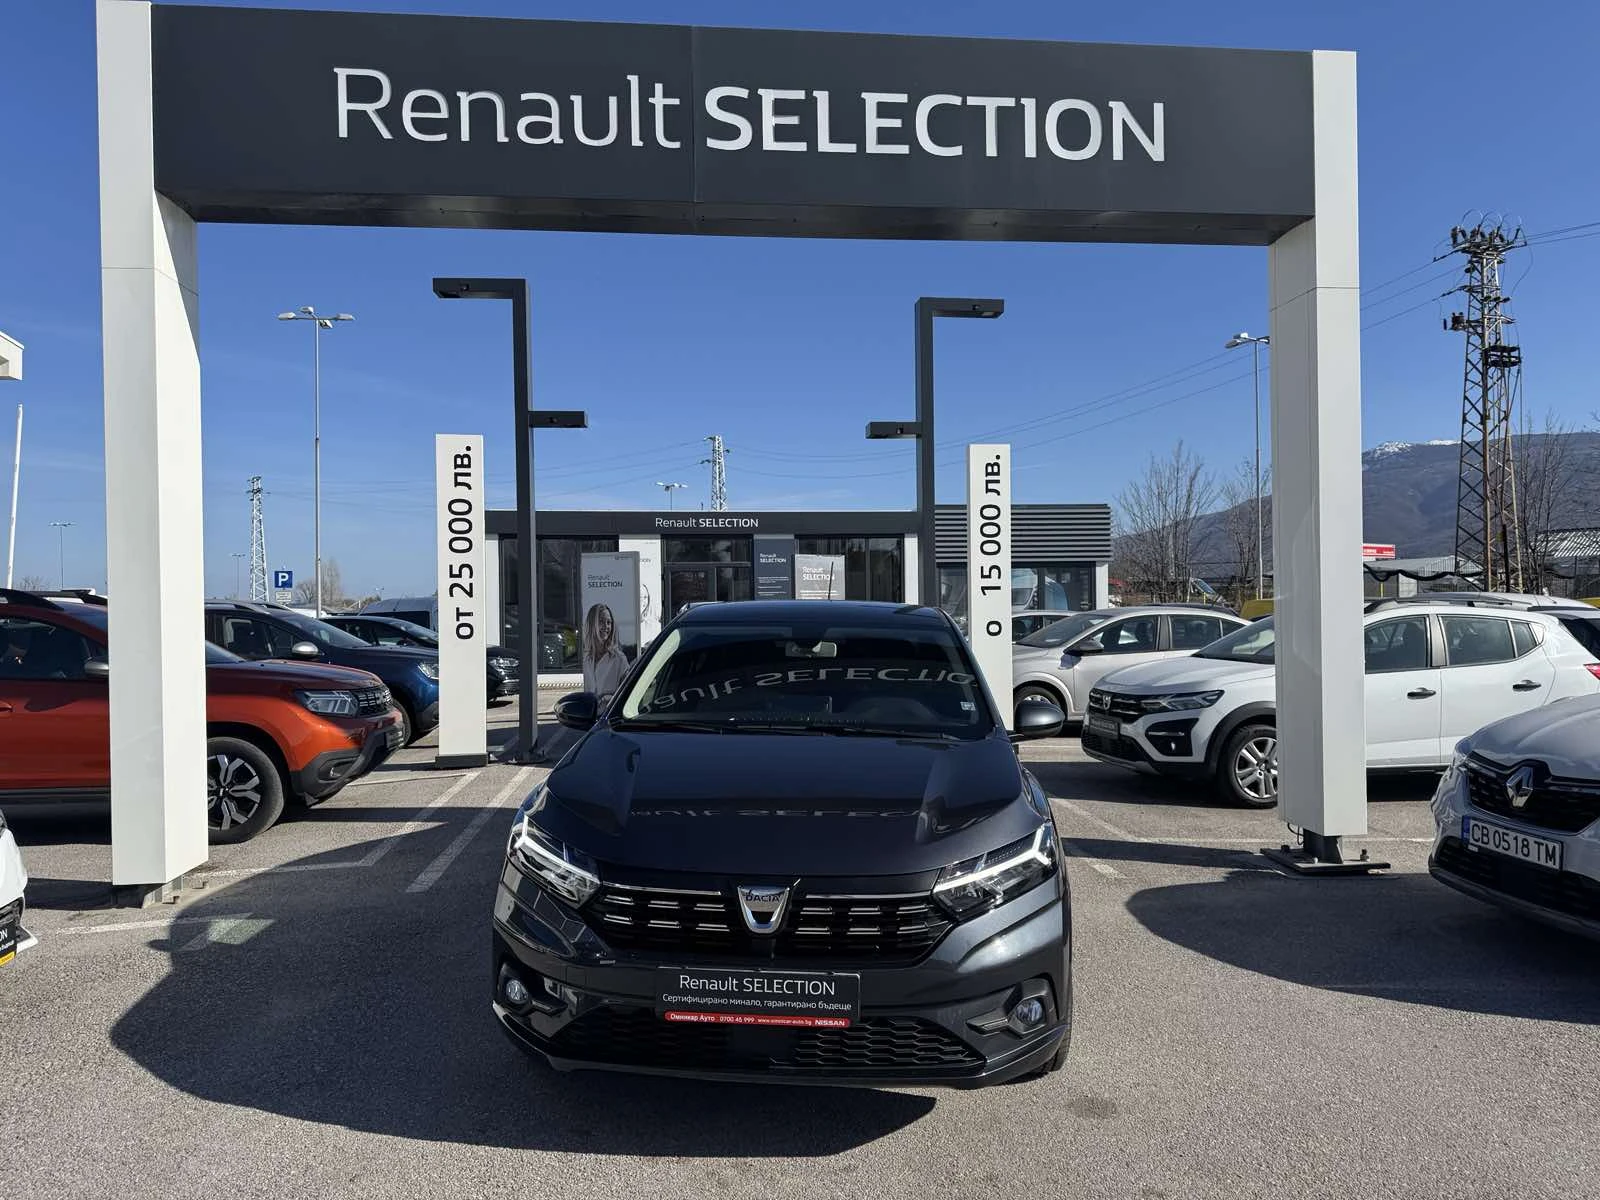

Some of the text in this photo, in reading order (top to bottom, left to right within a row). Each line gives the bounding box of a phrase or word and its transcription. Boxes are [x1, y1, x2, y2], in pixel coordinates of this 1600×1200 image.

[333, 67, 1165, 162] Renault SELECTION
[985, 454, 1001, 496] лв.
[655, 517, 759, 528] Renault SELECTION
[979, 504, 1002, 556] 000
[448, 445, 474, 640] от 25 000 лв.
[278, 572, 289, 587] P
[587, 581, 623, 589] SELECTION
[980, 564, 1002, 596] 15
[1471, 823, 1556, 866] CB 0518 TM
[745, 894, 780, 903] DACIA
[679, 974, 835, 995] Renault SELECTION
[662, 993, 852, 1011] Сертифицирано минало, гарантирано бъдеще
